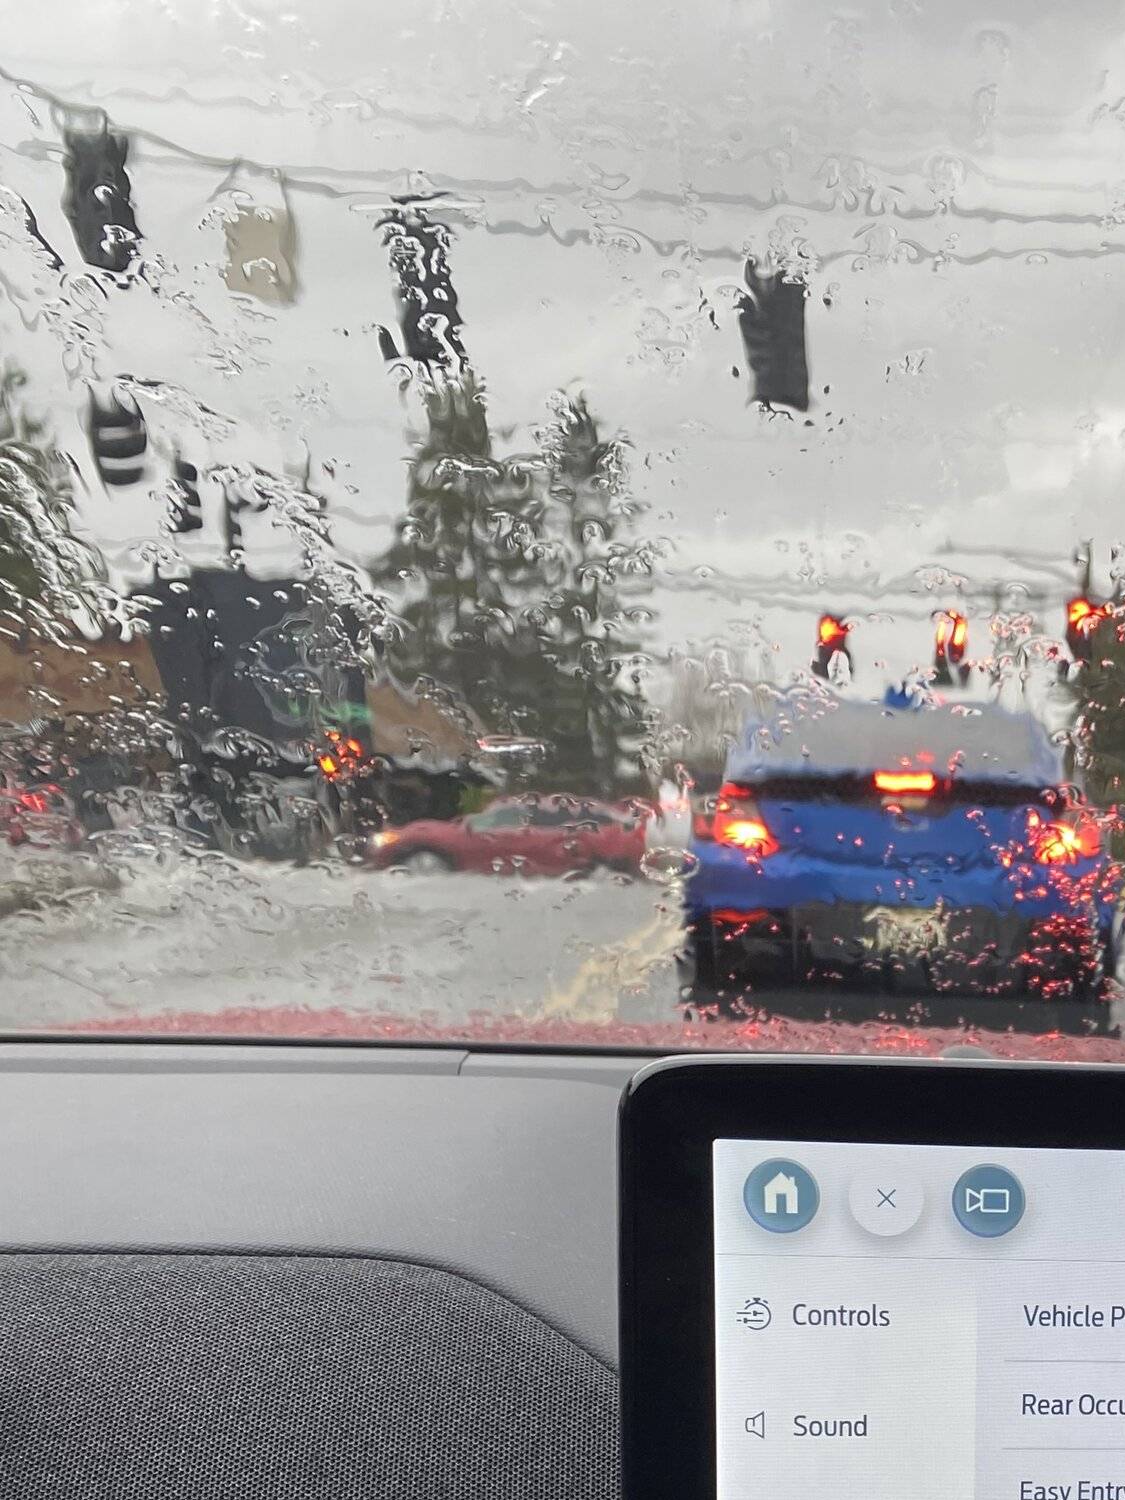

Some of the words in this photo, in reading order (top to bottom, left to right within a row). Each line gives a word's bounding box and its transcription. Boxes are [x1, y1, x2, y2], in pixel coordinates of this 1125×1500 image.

[793, 1304, 890, 1326] Controls
[1024, 1305, 1103, 1327] Vehicle
[1023, 1394, 1073, 1415] Rear
[794, 1415, 867, 1436] Sound
